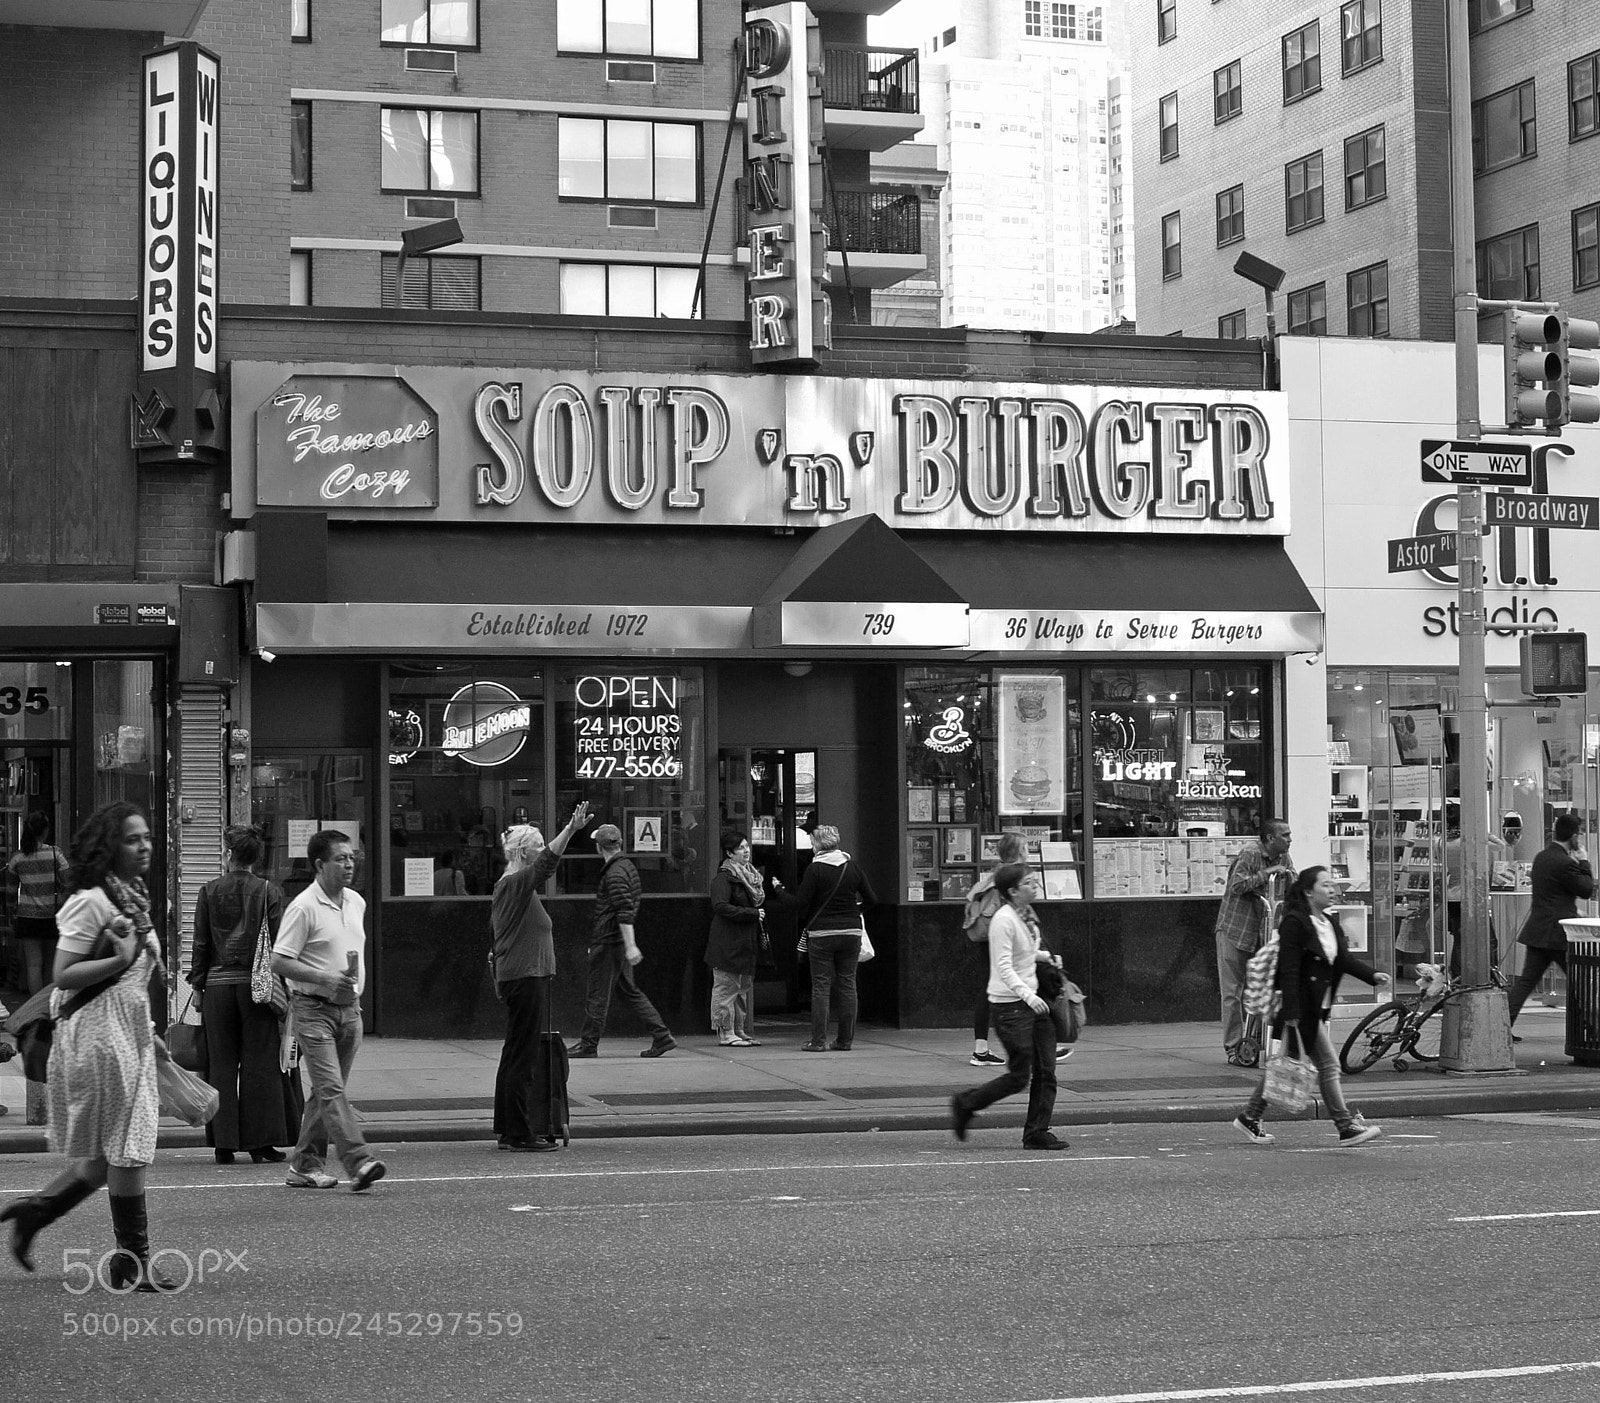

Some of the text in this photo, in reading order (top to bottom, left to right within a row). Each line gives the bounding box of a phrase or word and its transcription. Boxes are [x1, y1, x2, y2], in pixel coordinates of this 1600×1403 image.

[745, 18, 796, 348] DINER
[147, 70, 175, 357] LIQUORS
[196, 70, 215, 355] WINES
[272, 393, 341, 424] The
[287, 419, 434, 463] Famous
[474, 382, 731, 509] SOUP
[892, 394, 1274, 521] BURGER
[1433, 453, 1522, 473] ONE WAY
[320, 463, 411, 499] Cozy
[1495, 496, 1589, 528] Broadway
[1396, 535, 1450, 567] Astor Pl
[466, 611, 648, 637] Established 1972
[862, 613, 895, 635] 739
[1005, 616, 1263, 644] 36 Ways to Serve Burgers
[1422, 596, 1558, 637] stdio
[0, 686, 49, 715] 35
[576, 676, 676, 708] OPEN
[405, 709, 421, 725] TO
[578, 715, 680, 736] 24 HOURS
[577, 736, 680, 754] FREE DELIVERY
[924, 737, 973, 754] BROOKLYN
[577, 756, 678, 778] 477-5566
[1101, 759, 1177, 781] LIGHT
[1175, 780, 1262, 798] Heineken
[639, 821, 657, 842] A
